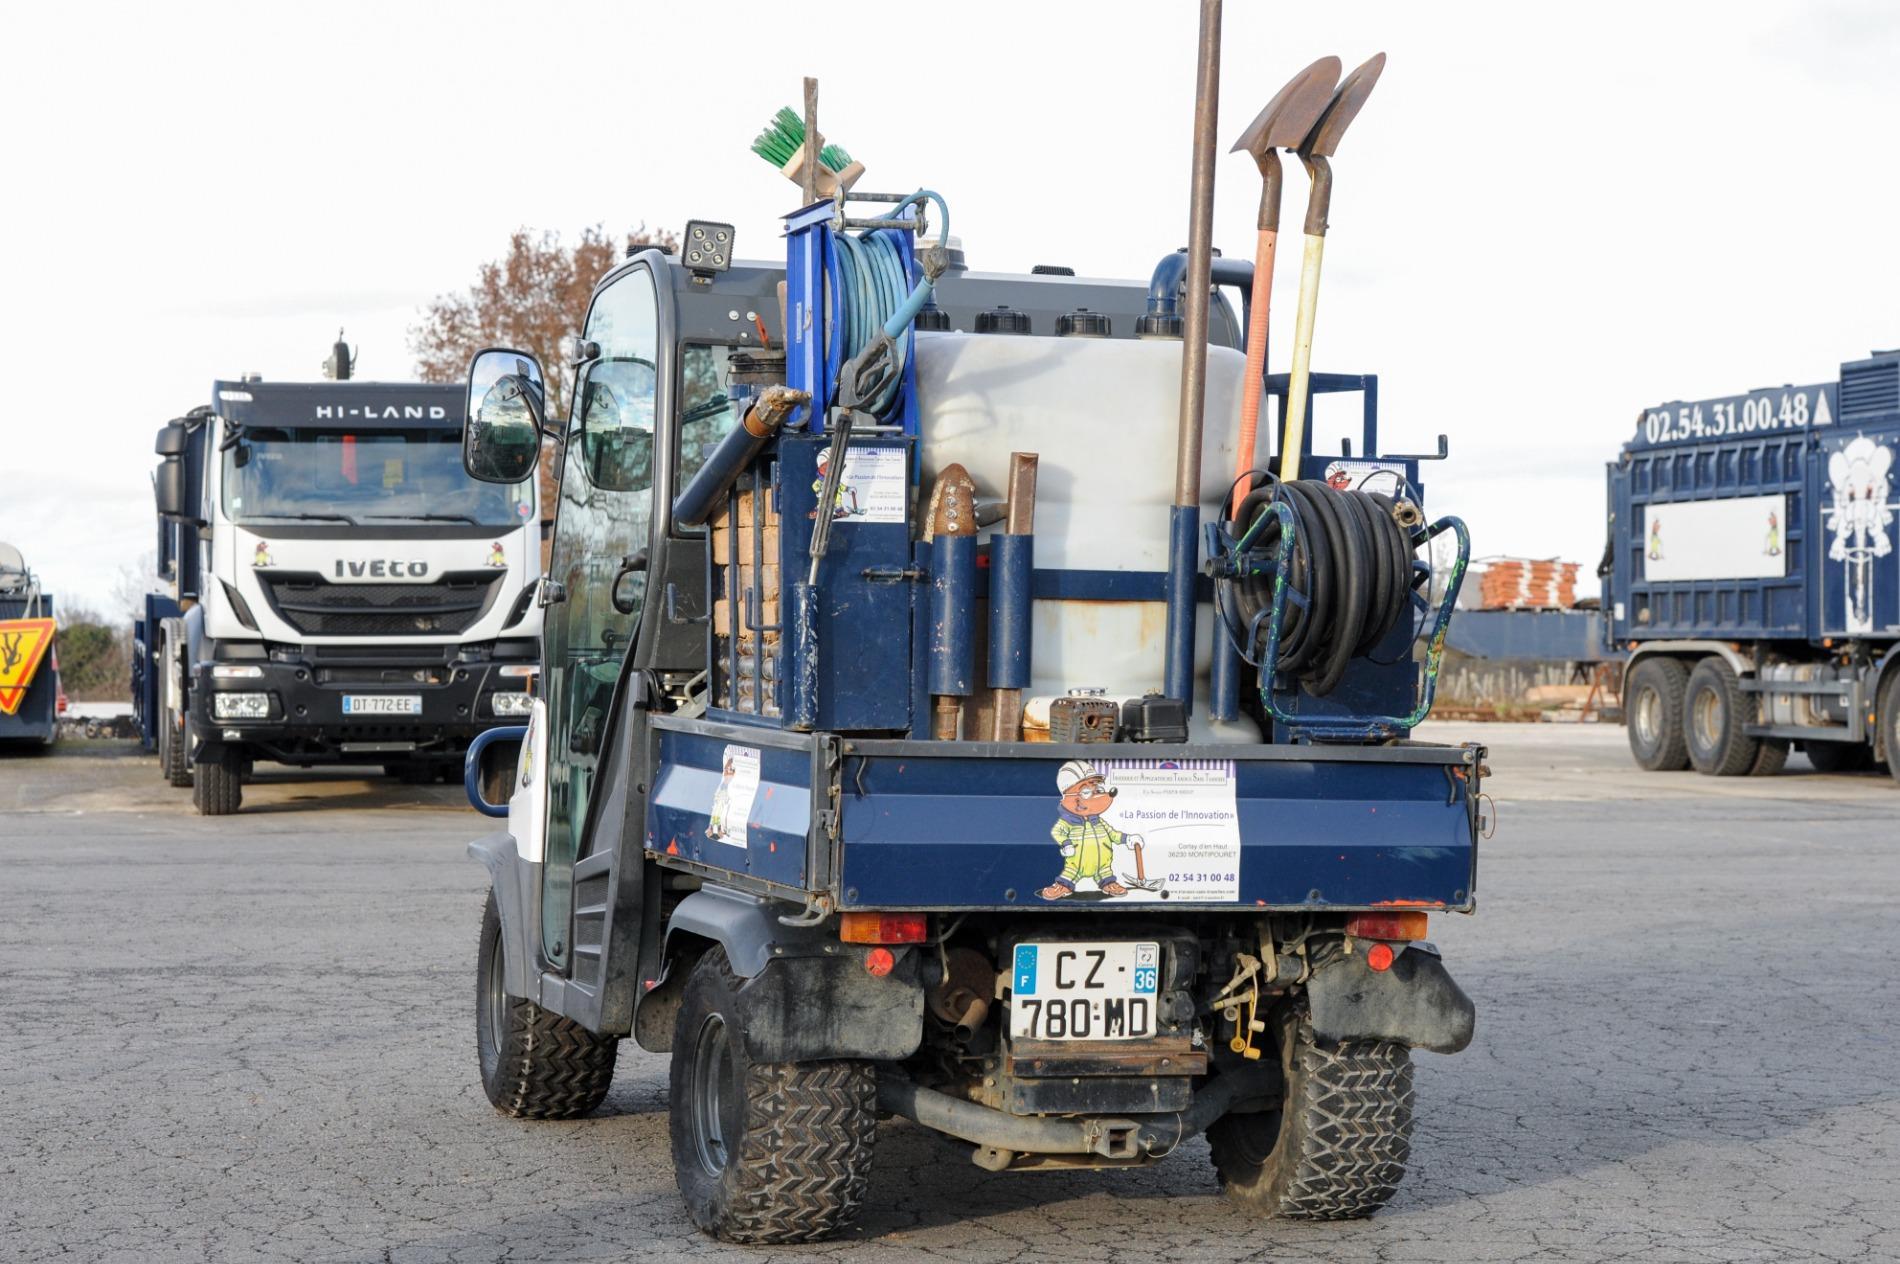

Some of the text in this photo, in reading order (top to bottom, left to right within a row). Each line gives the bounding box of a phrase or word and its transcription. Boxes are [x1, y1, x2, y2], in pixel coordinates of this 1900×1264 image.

[316, 405, 446, 419] HI-LAND
[1646, 393, 1809, 444] 02.54.31.00.48
[335, 559, 428, 577] IVECO
[1136, 810, 1166, 819] Passion
[1168, 810, 1179, 819] de
[1168, 873, 1235, 882] 02 54 31 00 48
[1021, 976, 1029, 987] F
[1136, 971, 1155, 989] 36
